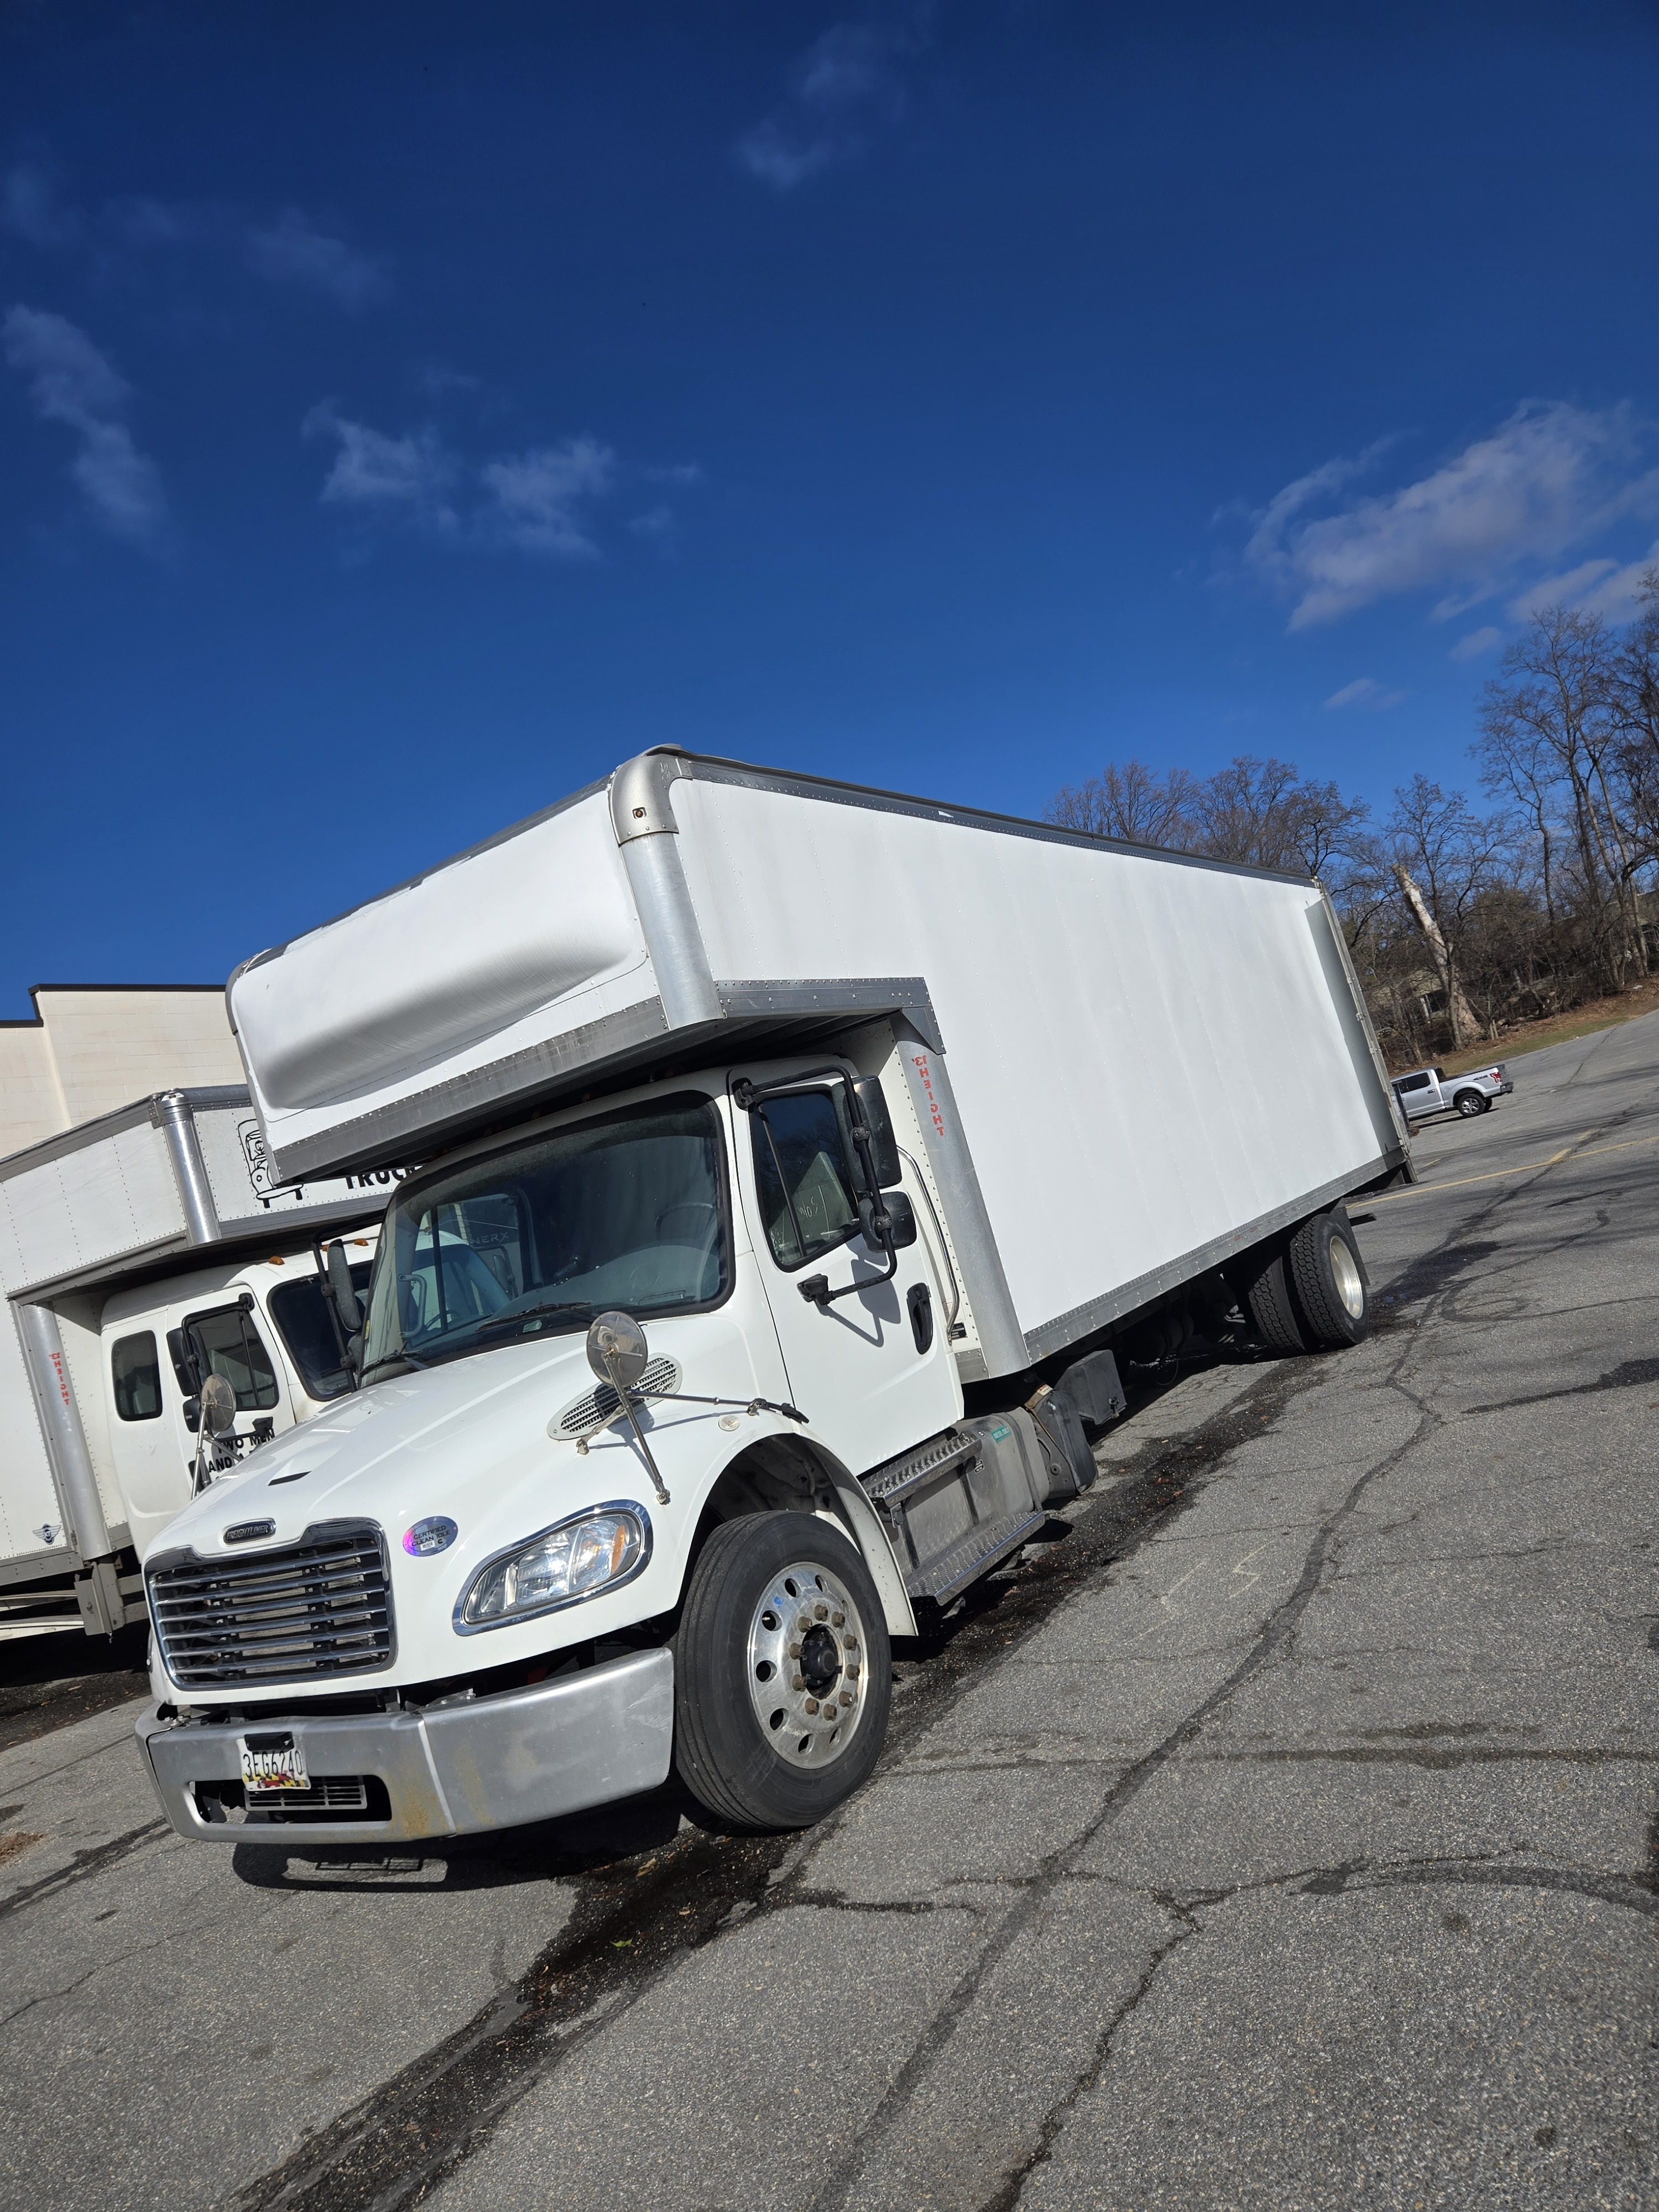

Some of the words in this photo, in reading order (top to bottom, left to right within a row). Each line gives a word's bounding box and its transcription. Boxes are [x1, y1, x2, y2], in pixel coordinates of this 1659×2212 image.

[208, 1457, 232, 1473] AND
[227, 1525, 268, 1540] FREIGHTLINER
[412, 1536, 434, 1546] CLEAN
[436, 1530, 451, 1538] IDLE
[414, 1526, 446, 1539] CERTIFIED
[243, 1750, 302, 1777] 3EG6240
